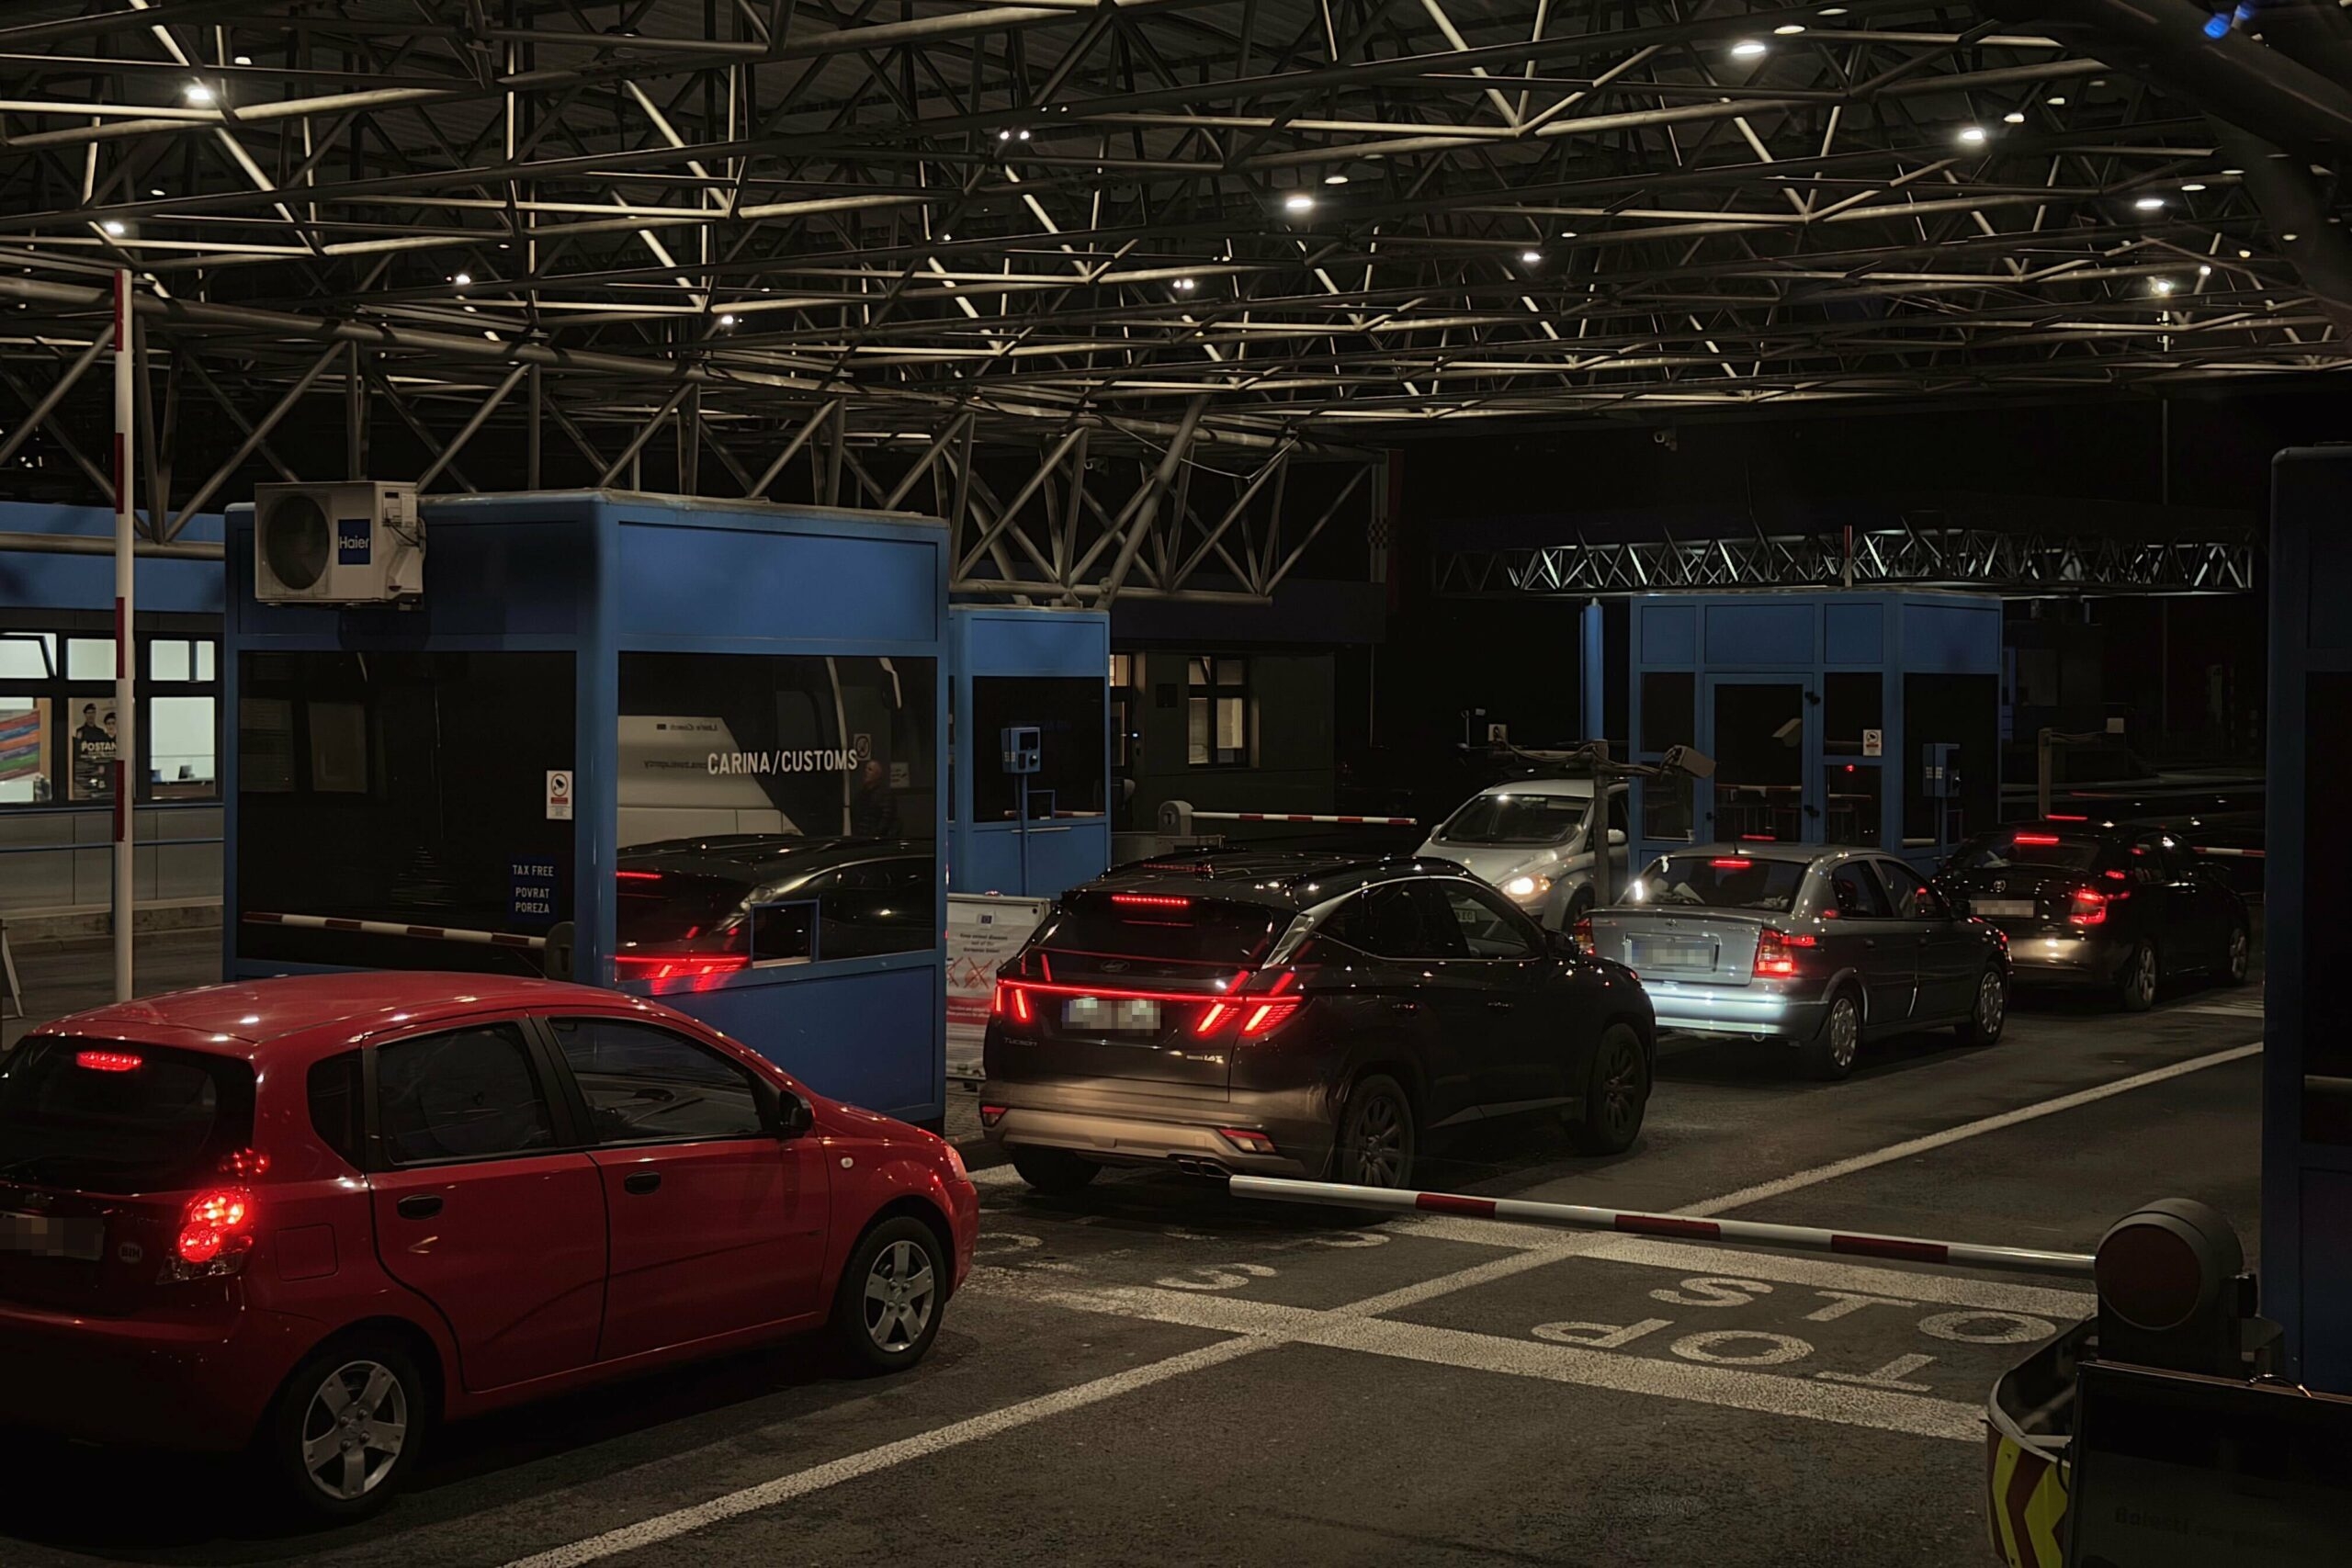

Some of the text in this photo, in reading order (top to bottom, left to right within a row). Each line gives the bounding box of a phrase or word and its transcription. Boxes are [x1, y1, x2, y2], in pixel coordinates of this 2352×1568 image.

[339, 535, 370, 548] Haier
[81, 740, 118, 751] POSTAN
[707, 750, 858, 775] CARINA/CUSTOMS
[512, 864, 554, 876] TAX FREE
[514, 886, 550, 898] POVRAT
[514, 901, 550, 913] POREZA
[1649, 1278, 2058, 1344] STO
[1532, 1317, 1937, 1392] TOP
